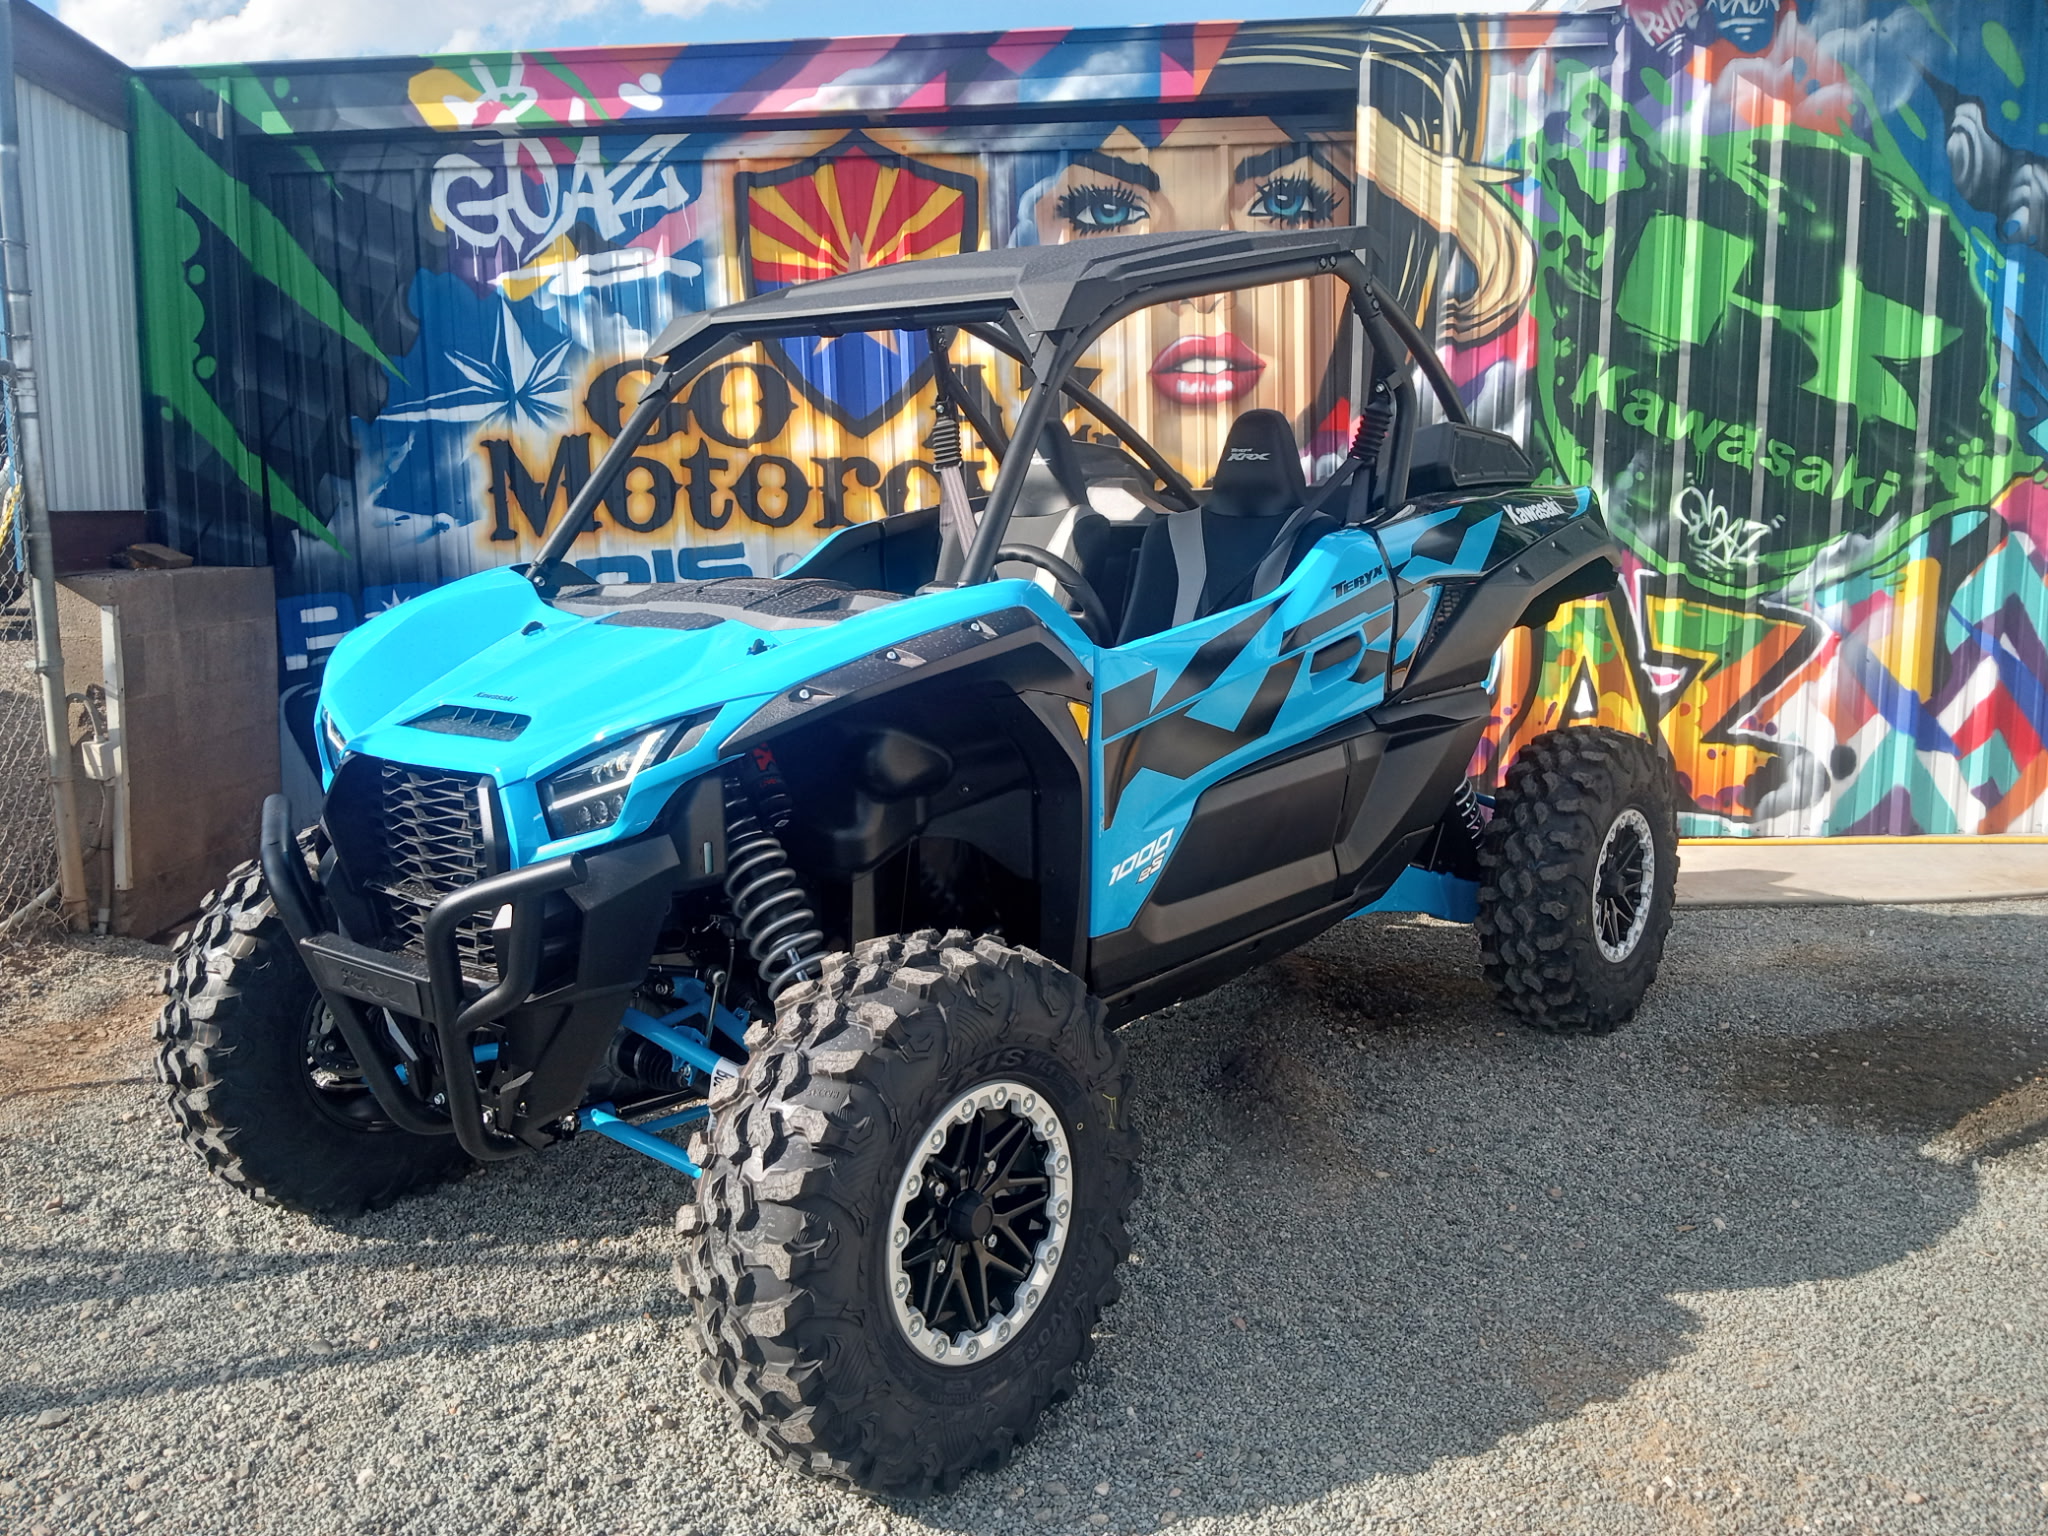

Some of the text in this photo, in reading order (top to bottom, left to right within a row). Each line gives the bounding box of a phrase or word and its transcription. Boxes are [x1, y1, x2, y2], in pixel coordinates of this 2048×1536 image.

[582, 358, 799, 449] GO
[1570, 353, 1901, 517] Kawasaki
[1227, 453, 1271, 462] KRX
[1502, 496, 1566, 526] Kawasaki
[473, 691, 519, 703] Kawasaki
[1108, 828, 1175, 887] 1000
